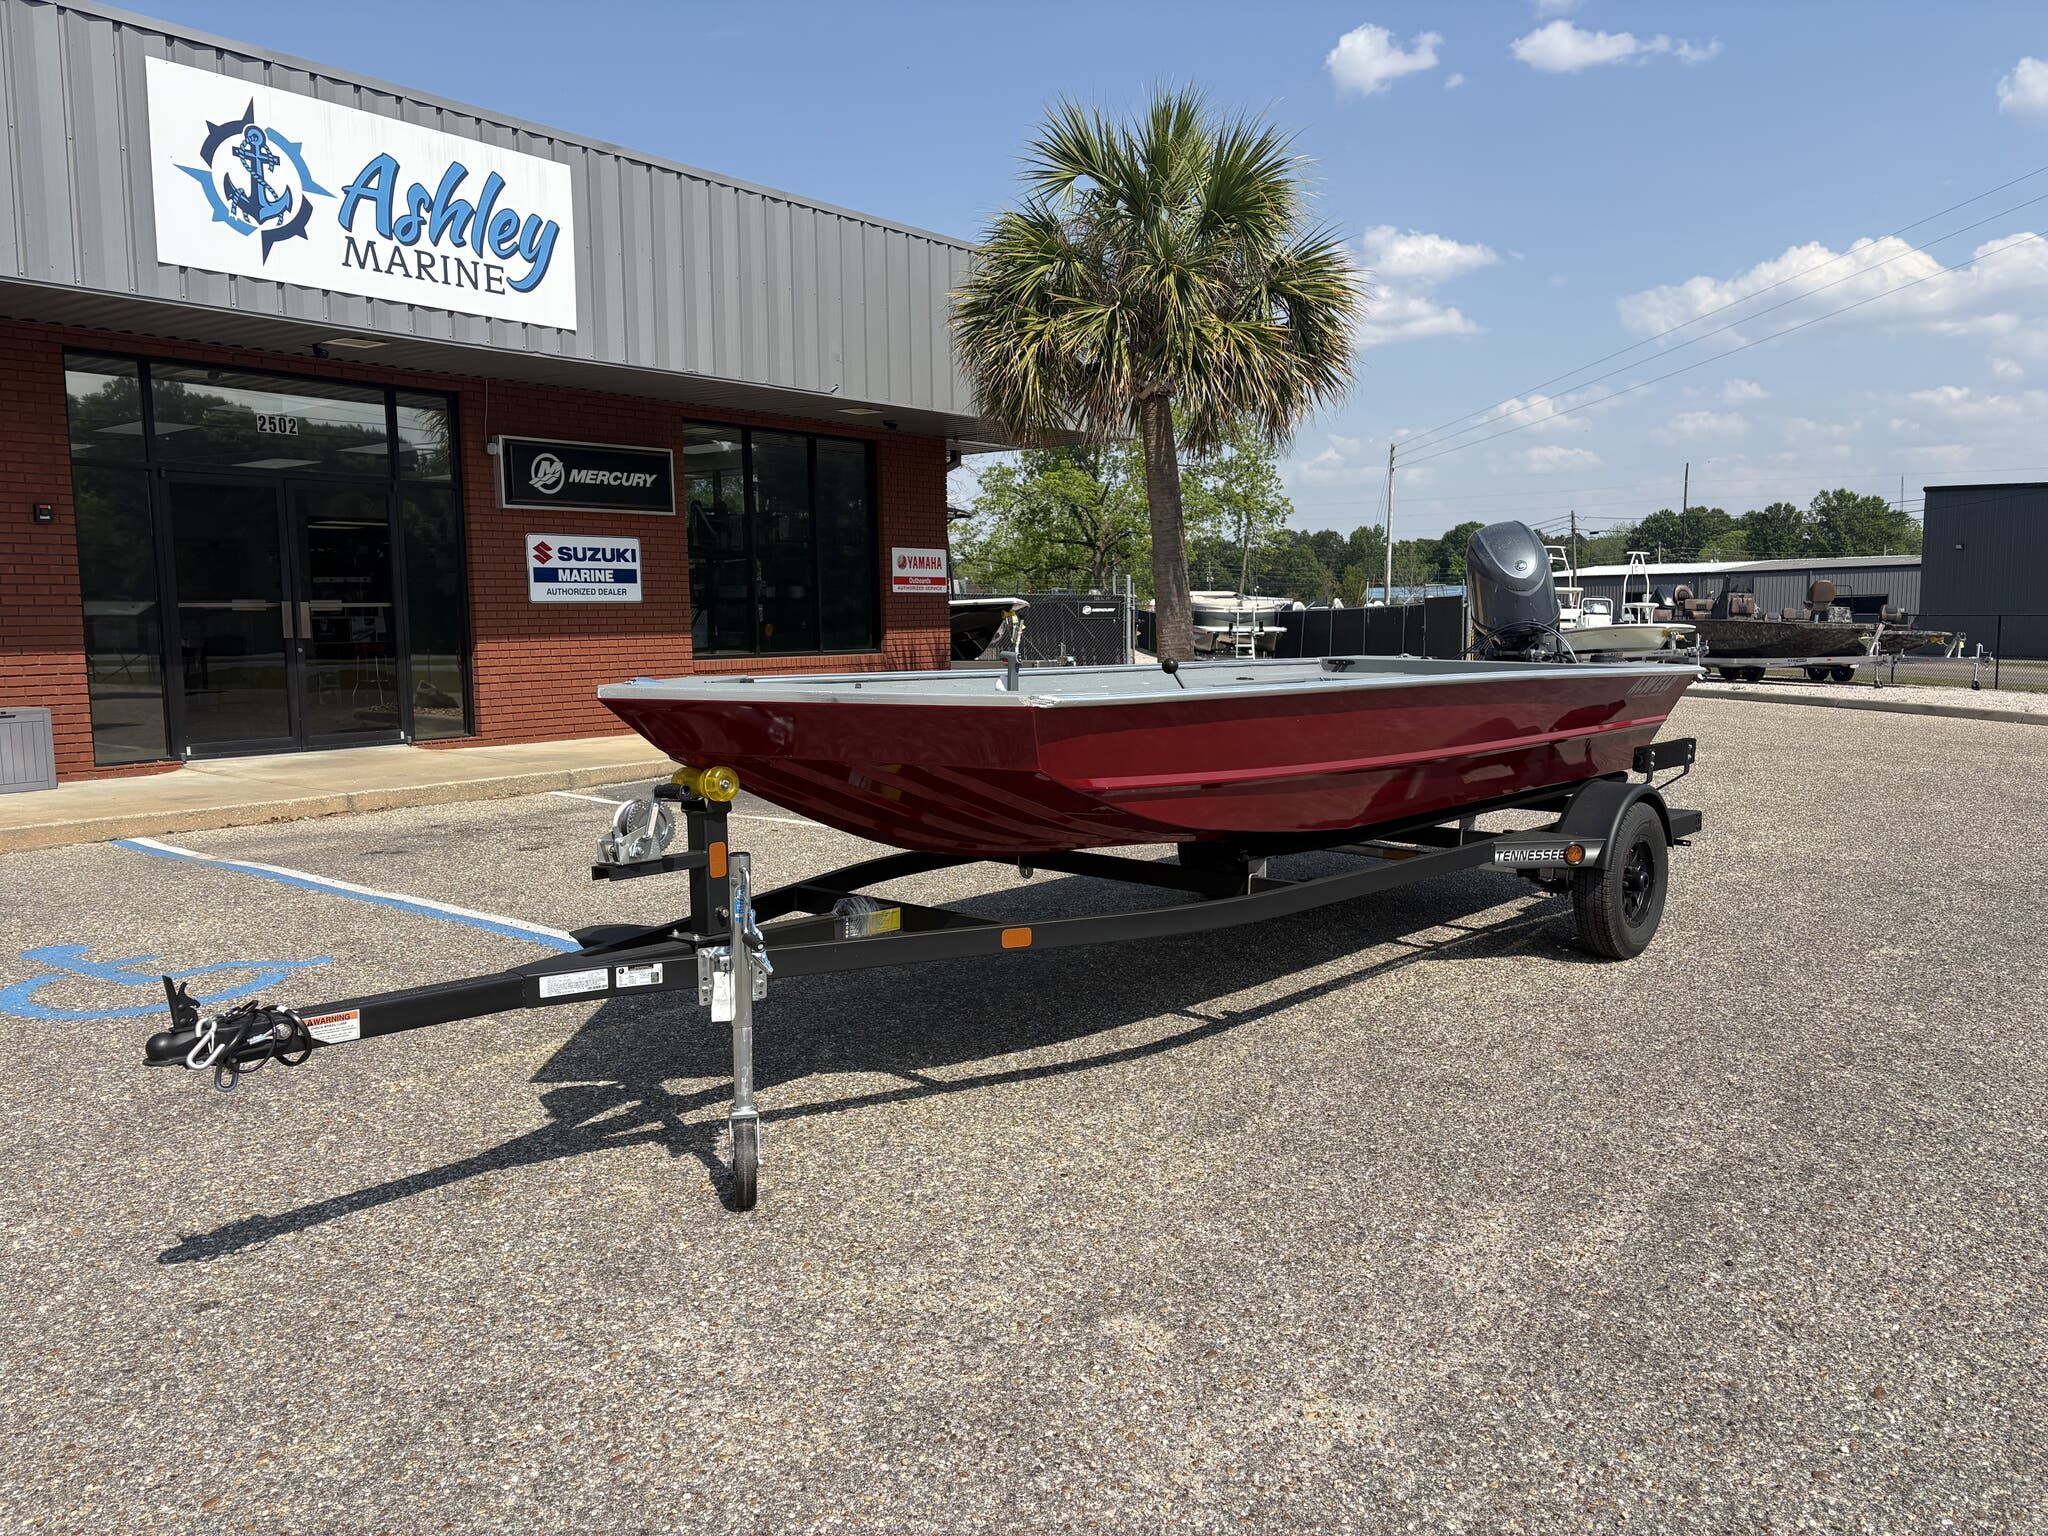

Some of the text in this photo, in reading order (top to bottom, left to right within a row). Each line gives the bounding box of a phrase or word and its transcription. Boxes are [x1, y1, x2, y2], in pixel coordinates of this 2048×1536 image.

[338, 152, 560, 294] Ashley
[342, 236, 506, 295] MARINE
[258, 415, 297, 434] 2502
[568, 469, 658, 488] MERCURY
[557, 546, 637, 563] SUZUKI
[907, 556, 943, 570] YAMAHA
[557, 569, 615, 582] MARINE
[546, 587, 627, 596] AUTHORIZED DEALER
[313, 1013, 351, 1025] WARNING
